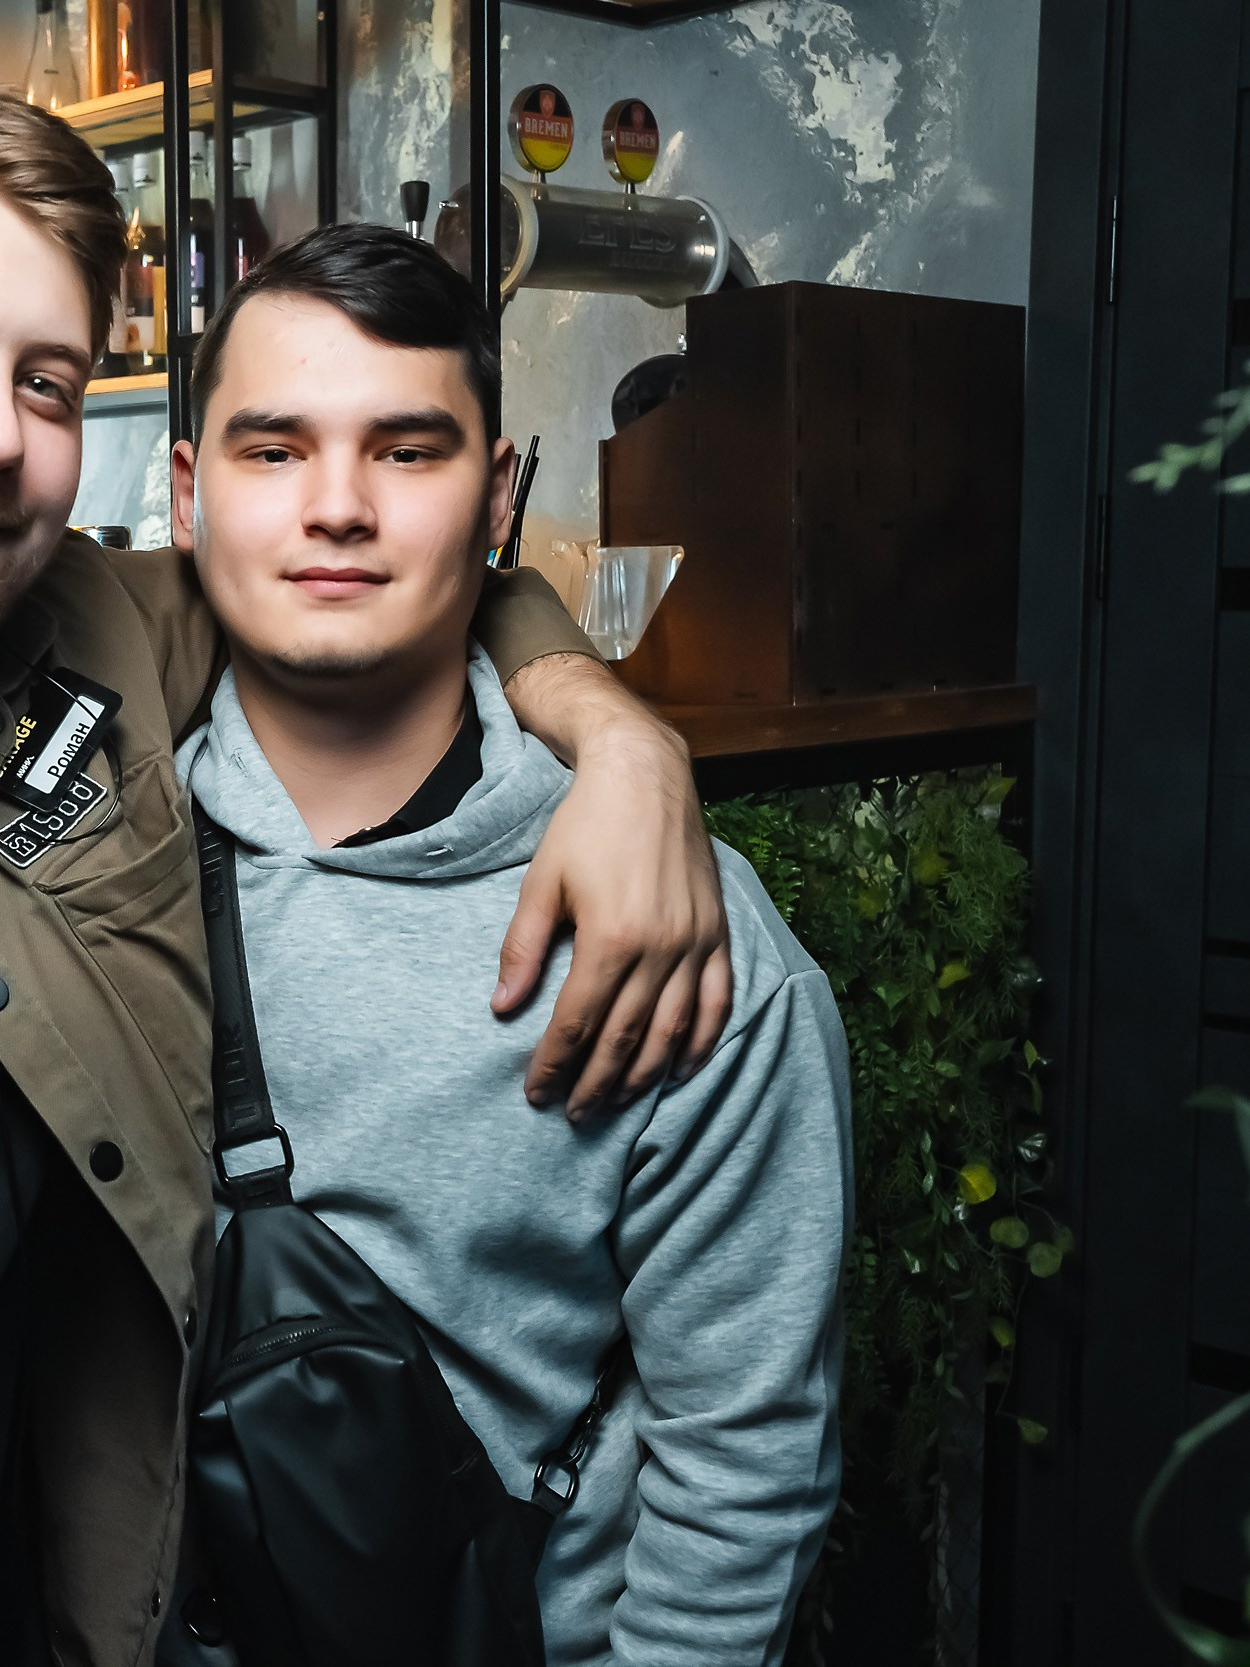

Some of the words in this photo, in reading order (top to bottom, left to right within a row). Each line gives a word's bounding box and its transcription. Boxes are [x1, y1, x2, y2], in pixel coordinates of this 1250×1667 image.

[524, 117, 568, 138] BREMEN
[618, 131, 656, 149] BREMEN
[47, 722, 91, 777] Роман
